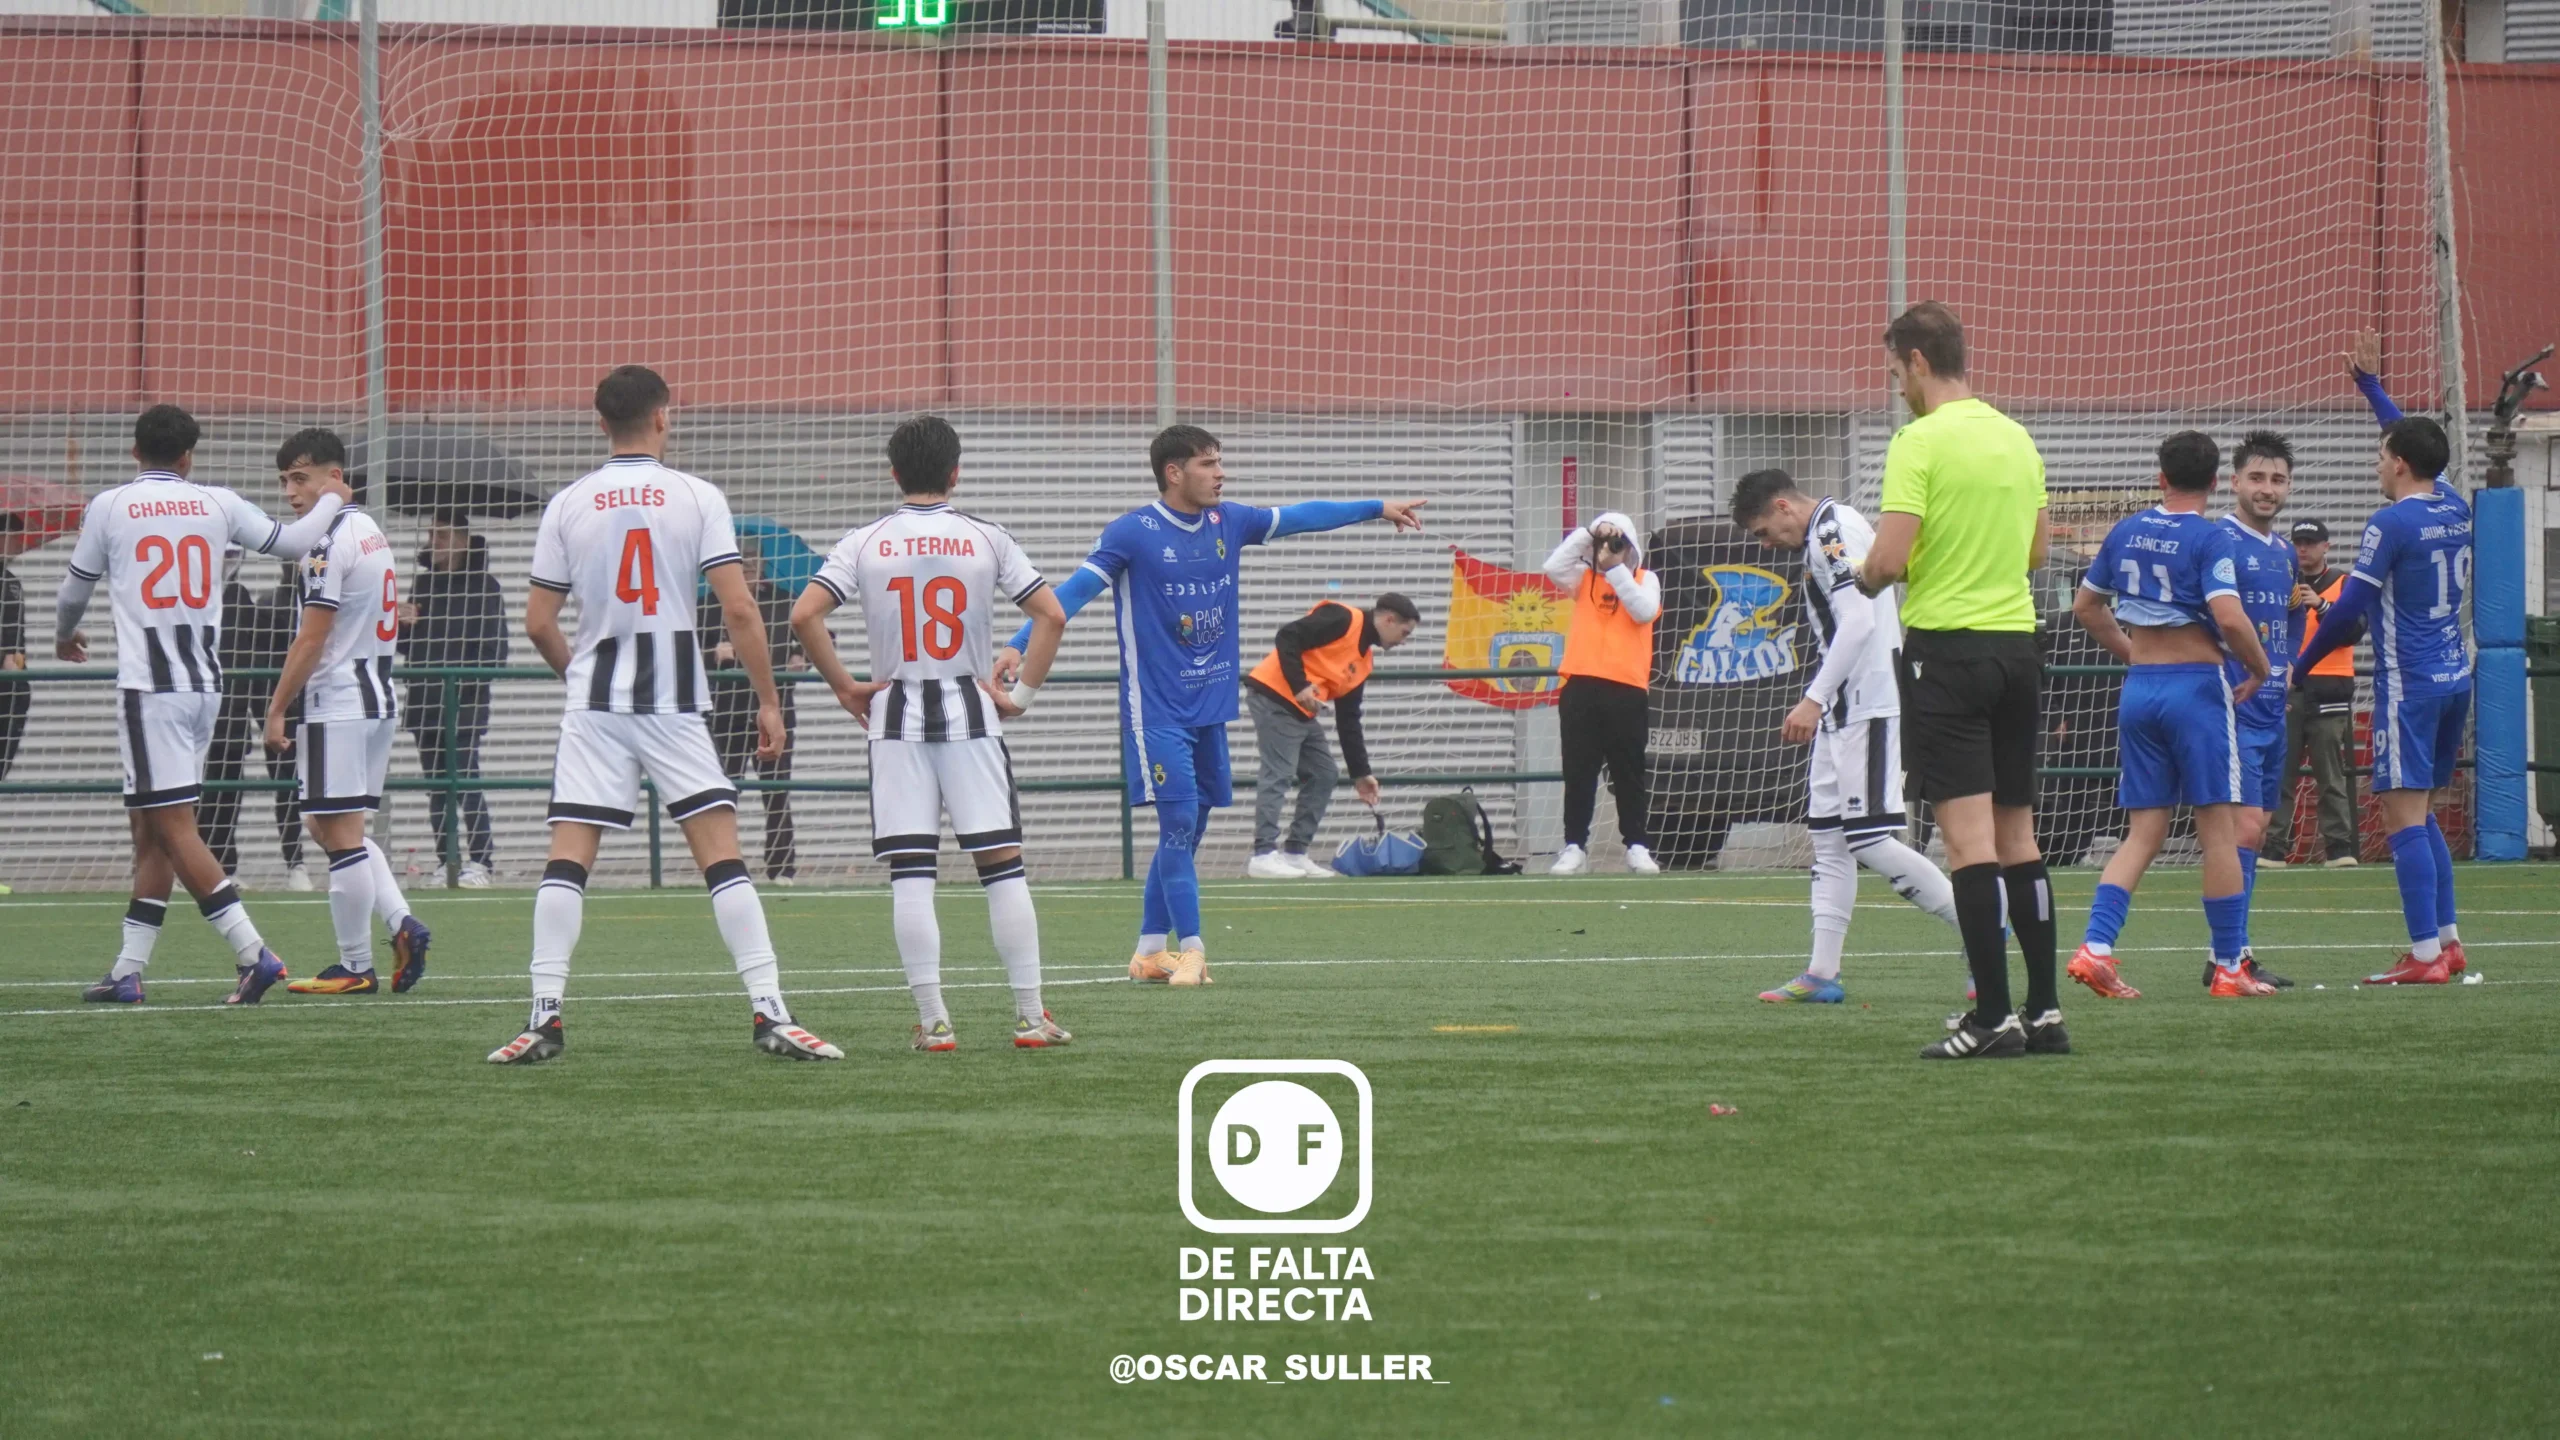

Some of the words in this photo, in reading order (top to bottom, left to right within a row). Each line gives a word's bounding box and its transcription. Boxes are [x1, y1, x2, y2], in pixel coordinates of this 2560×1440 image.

[128, 500, 209, 519] CHARBEL
[594, 484, 665, 511] SELLÉS
[879, 539, 899, 557] G.
[904, 536, 976, 557] TERMA
[2420, 525, 2447, 540] JAUME
[135, 534, 211, 610] 20
[615, 528, 660, 615] 4
[2120, 558, 2174, 603] 11
[376, 568, 399, 642] 9
[886, 576, 968, 662] 18
[1677, 626, 1799, 684] GALLOS
